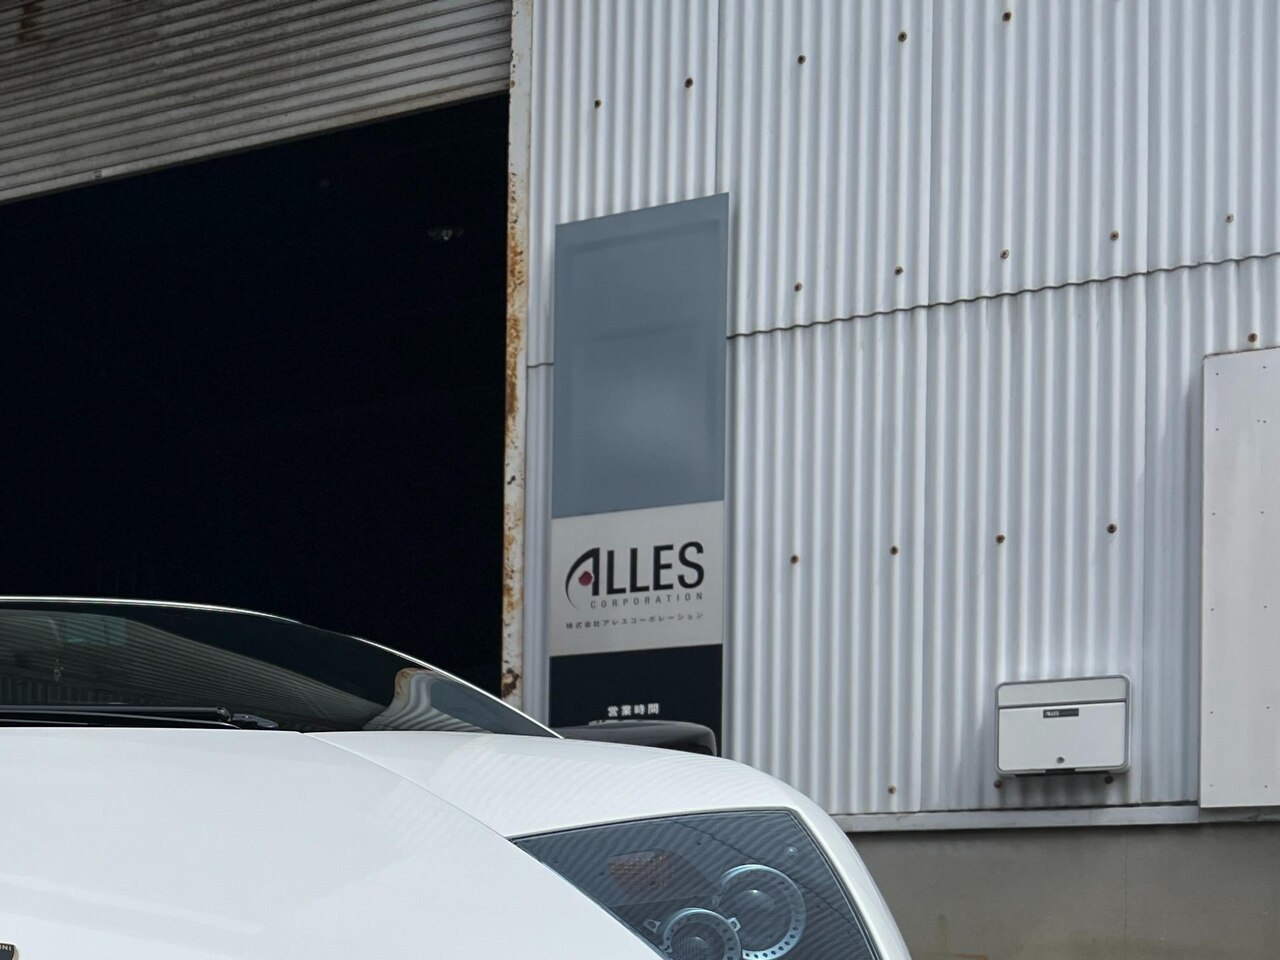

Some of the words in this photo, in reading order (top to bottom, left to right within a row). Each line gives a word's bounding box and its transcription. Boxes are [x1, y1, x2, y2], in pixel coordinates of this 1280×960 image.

[565, 541, 705, 610] ALLES
[590, 592, 703, 609] CORPORATION
[607, 703, 659, 717] 営業時間
